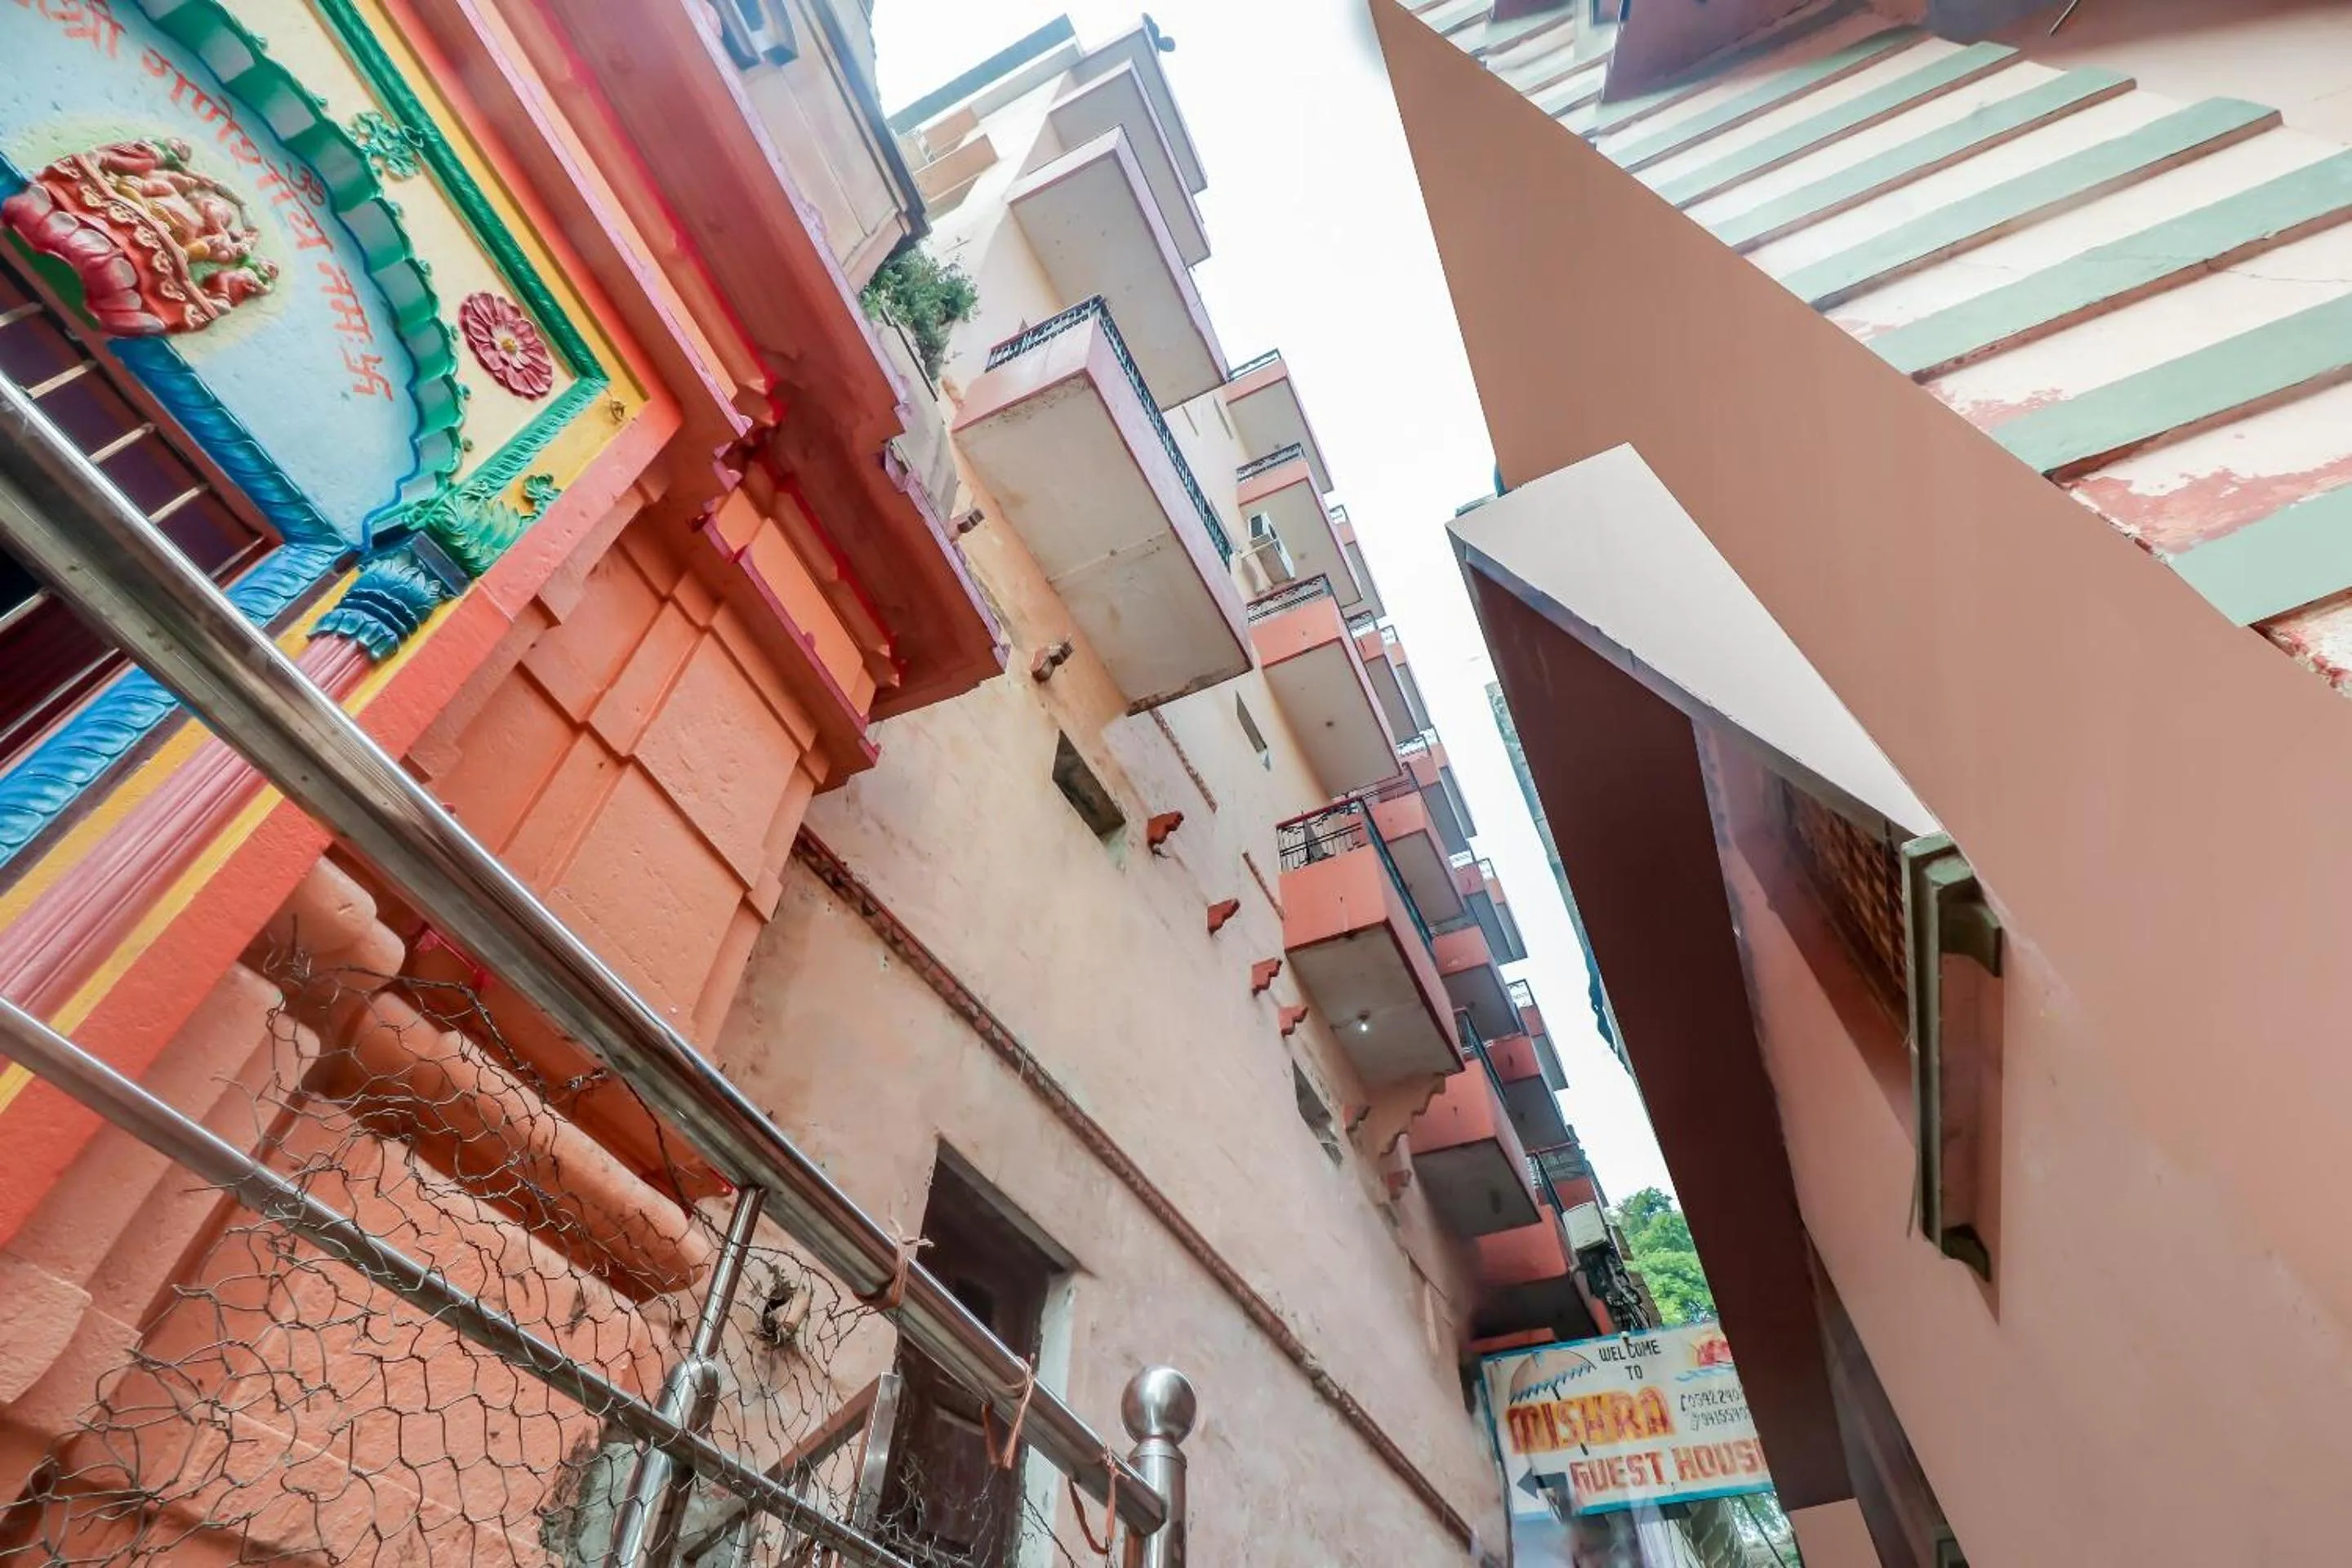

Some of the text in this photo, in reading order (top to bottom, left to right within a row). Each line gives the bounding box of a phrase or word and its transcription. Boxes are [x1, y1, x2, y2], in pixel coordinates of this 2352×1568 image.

[1624, 1365, 1644, 1380] TO
[1507, 1386, 1674, 1455] MISHRA
[1570, 1450, 1667, 1495] GUEST
